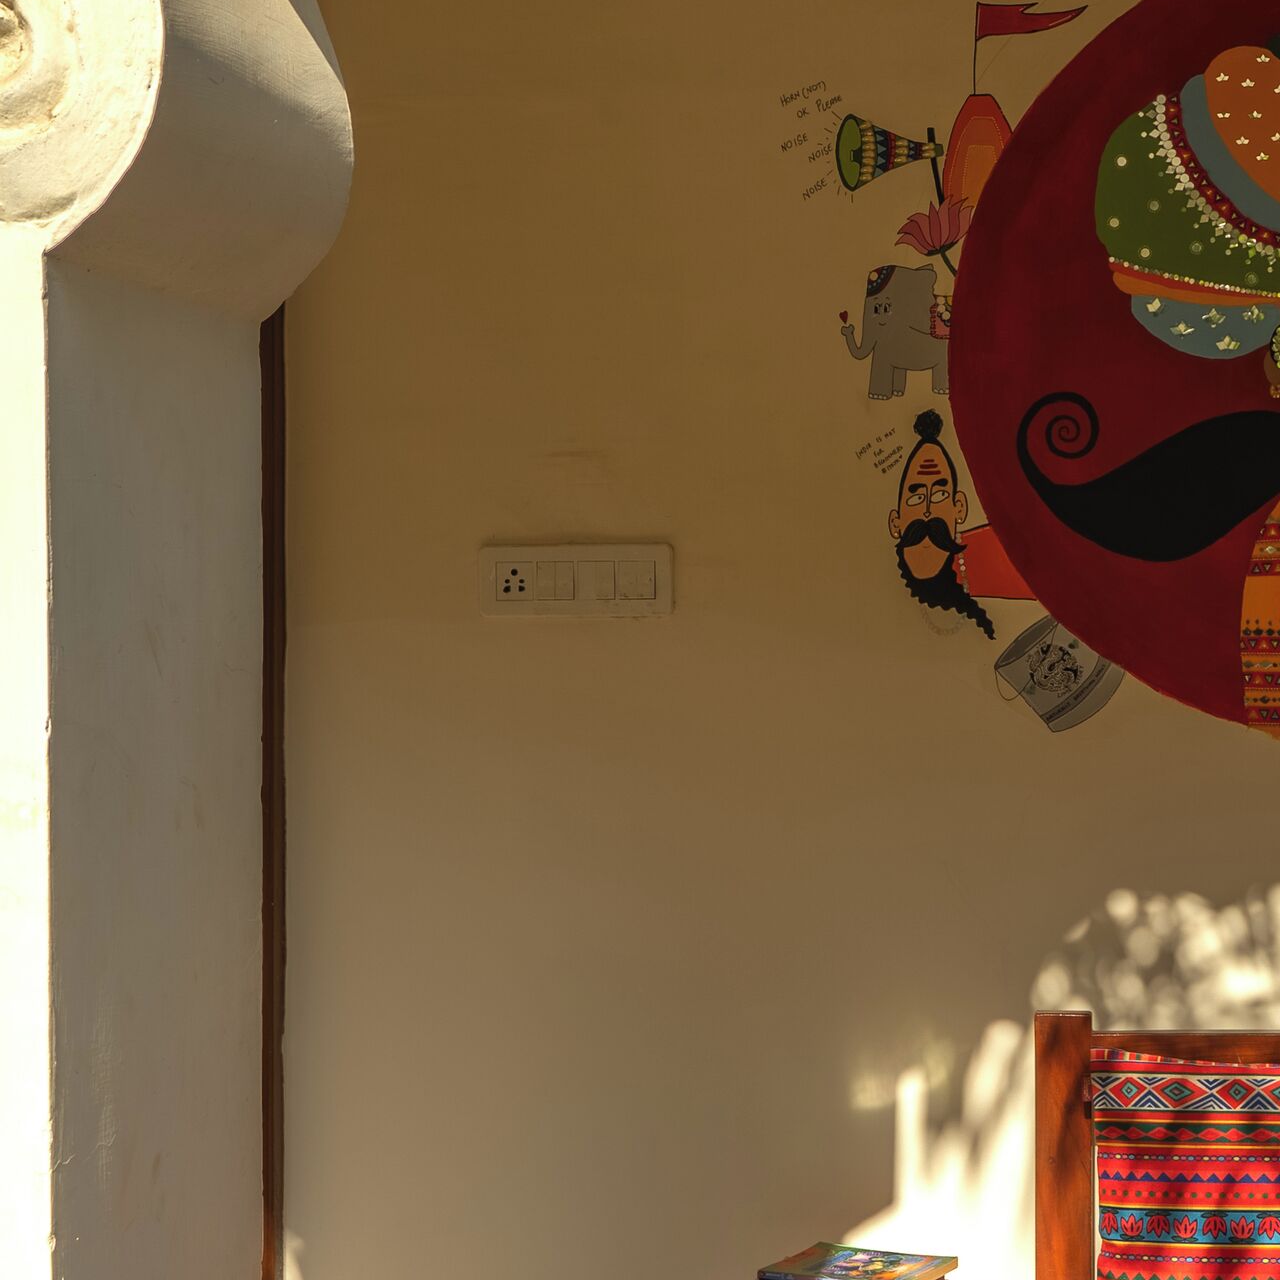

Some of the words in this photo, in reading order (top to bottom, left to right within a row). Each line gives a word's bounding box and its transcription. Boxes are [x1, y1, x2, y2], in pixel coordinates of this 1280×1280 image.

[779, 91, 800, 107] HORN
[801, 80, 826, 99] (NOT)
[796, 107, 809, 119] OK
[780, 132, 808, 152] NOISE
[808, 143, 833, 163] NOISE
[802, 177, 827, 200] NOISE
